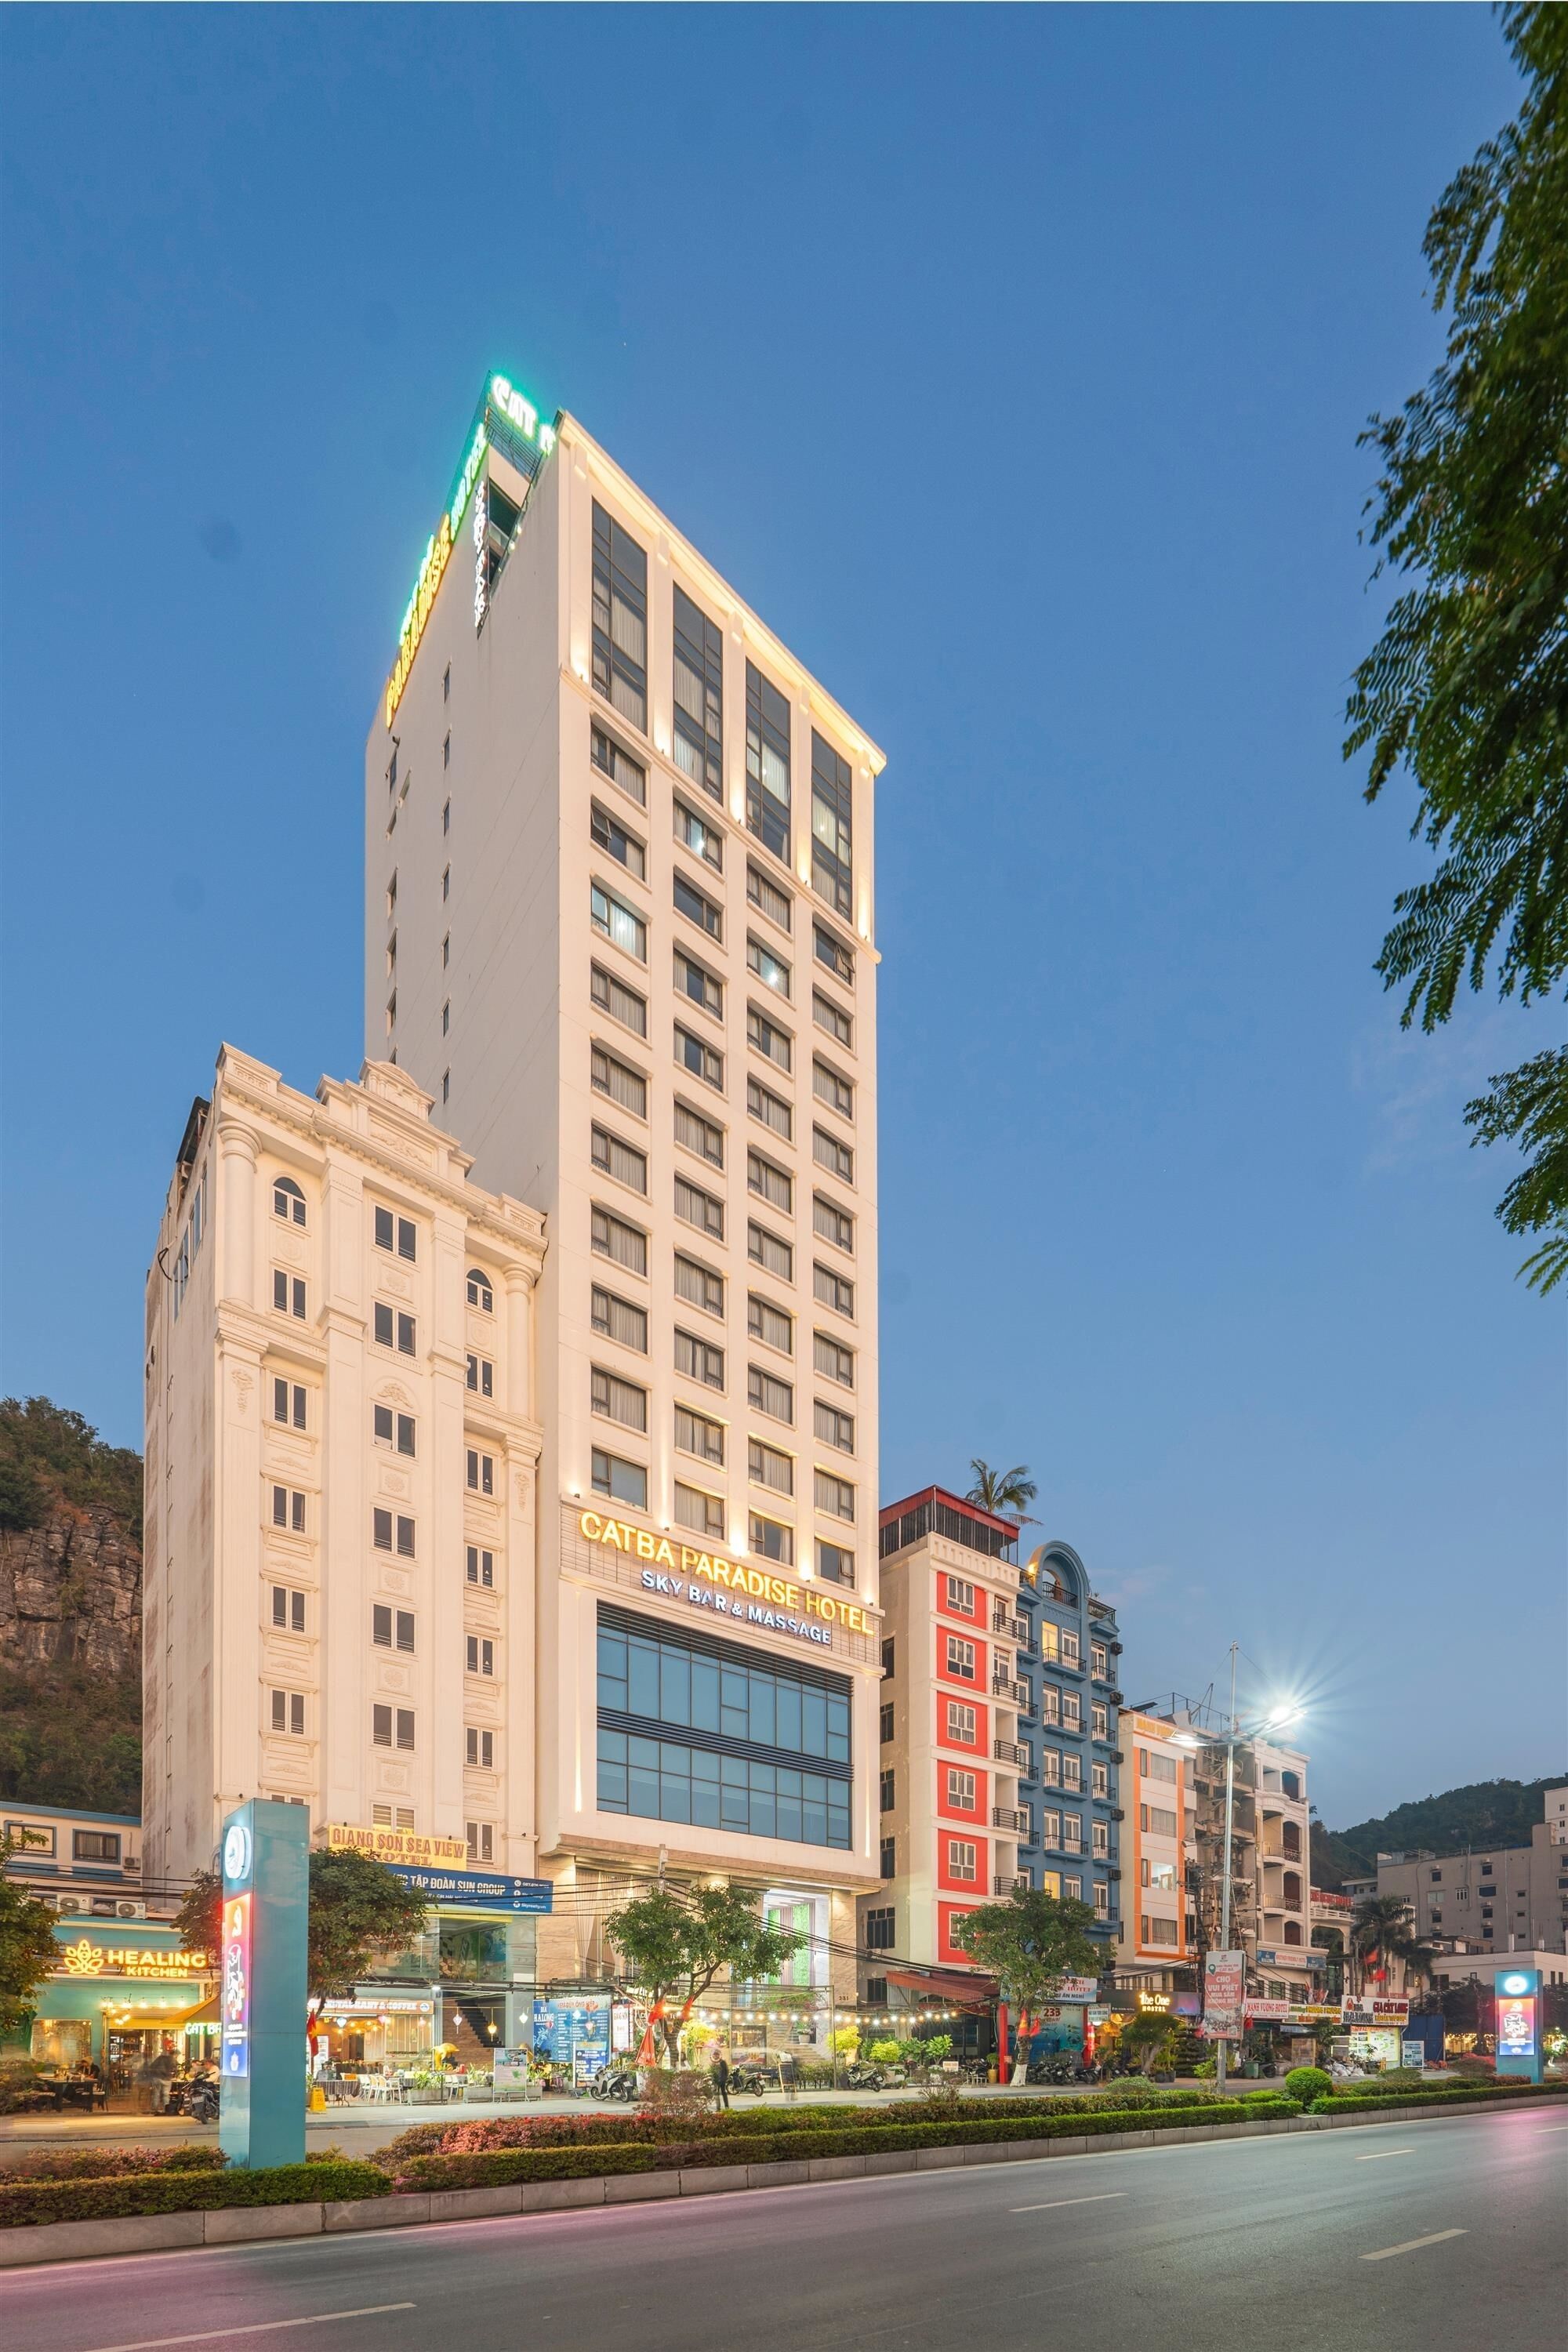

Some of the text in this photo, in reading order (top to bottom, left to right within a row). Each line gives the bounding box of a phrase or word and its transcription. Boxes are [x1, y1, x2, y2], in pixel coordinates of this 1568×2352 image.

[579, 1510, 876, 1636] CATBA PARADISE HOTEL
[641, 1569, 833, 1646] SKY BAR & MASSAGE
[331, 1827, 375, 1849] GIANG
[405, 1836, 432, 1856] SEA
[433, 1840, 466, 1859] VIEW
[375, 1851, 433, 1867] OTEL
[430, 1875, 456, 1890] ĐOÀN
[107, 1950, 207, 1968] HEALING
[126, 1966, 188, 1978] KITCHEN
[1155, 1994, 1171, 2006] One
